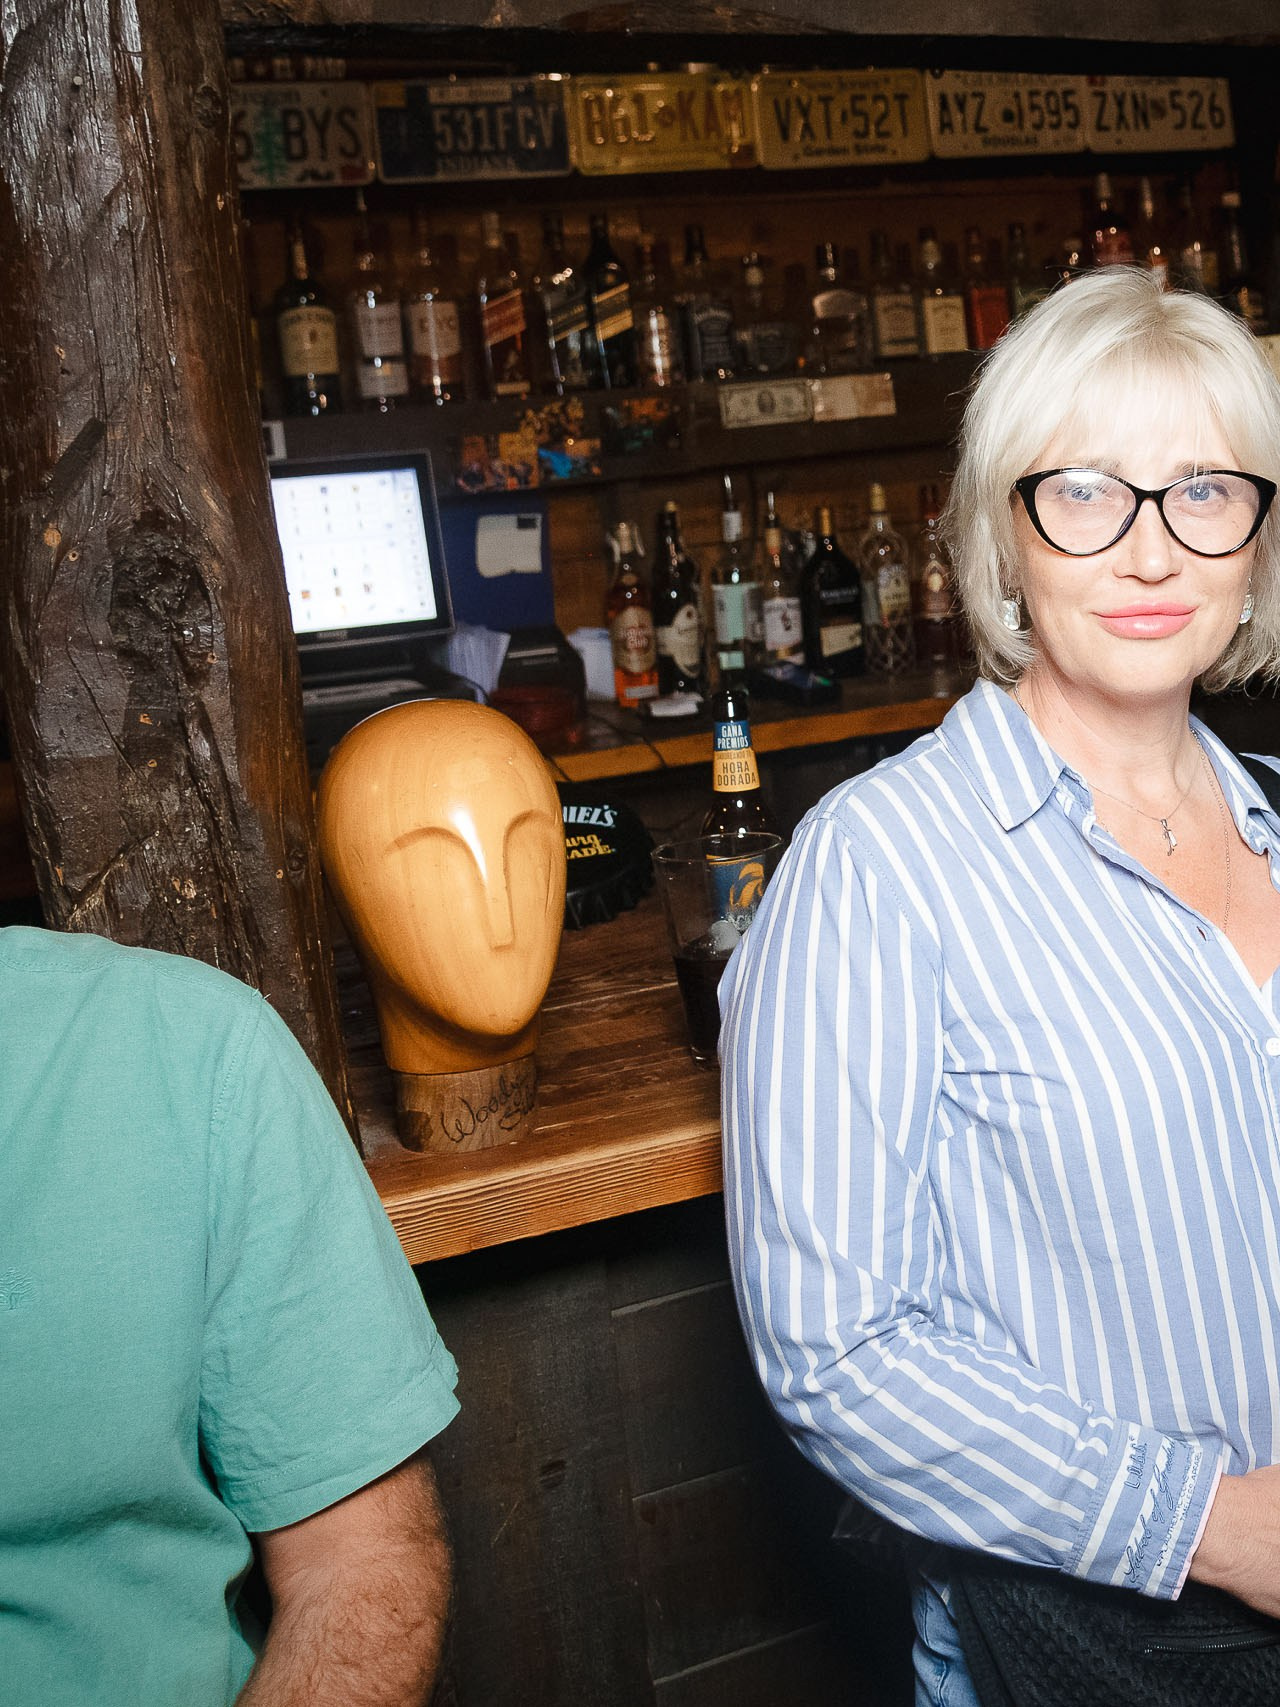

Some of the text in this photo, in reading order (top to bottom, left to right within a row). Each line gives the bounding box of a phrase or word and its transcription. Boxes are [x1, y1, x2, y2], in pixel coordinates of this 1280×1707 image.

[773, 94, 835, 143] VXT
[940, 91, 989, 134] AYZ
[1093, 89, 1226, 131] ZXN 526
[283, 106, 362, 162] BYS
[717, 736, 749, 750] PREMIOS
[721, 725, 744, 738] GANA
[717, 772, 756, 786] DORADA
[722, 761, 750, 774] HORA
